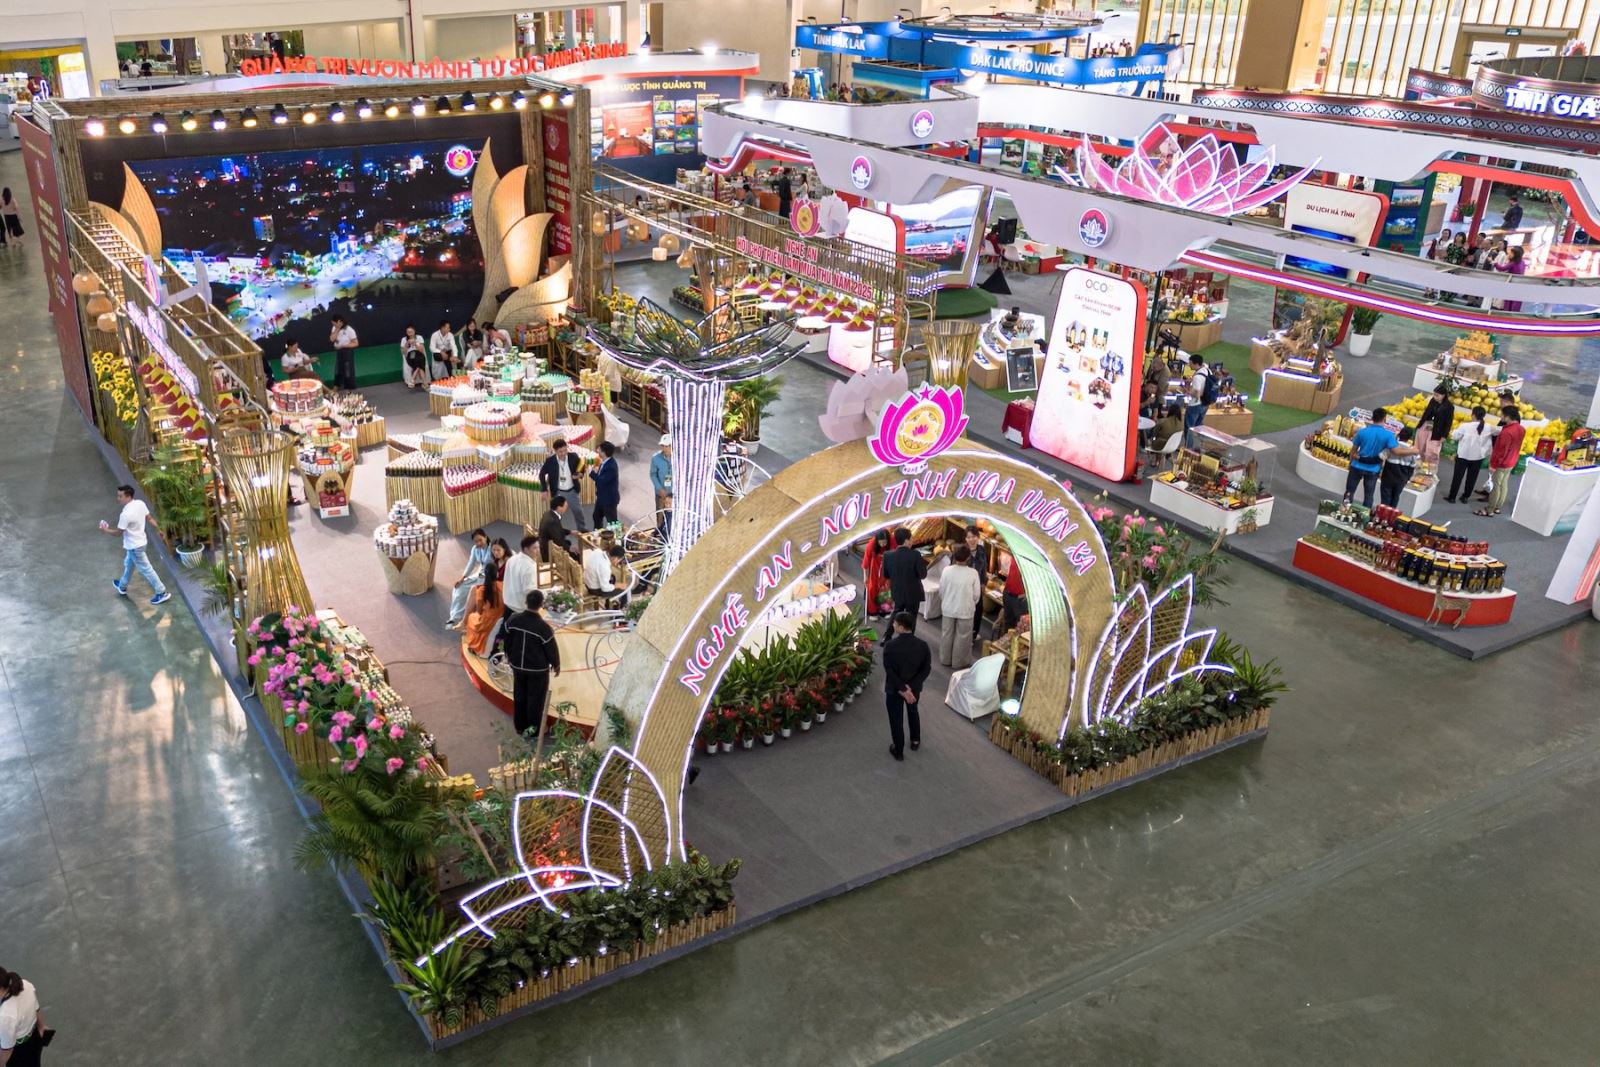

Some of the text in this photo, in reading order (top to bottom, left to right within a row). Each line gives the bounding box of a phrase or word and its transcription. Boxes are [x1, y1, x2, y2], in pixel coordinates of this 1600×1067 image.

[240, 52, 317, 78] QUẢNG
[320, 55, 348, 79] TRỊ
[418, 55, 472, 80] MÌNH
[992, 55, 1012, 71] LAK
[662, 79, 692, 90] QUẢNG
[693, 80, 706, 91] TRỊ
[1552, 92, 1597, 119] GIA
[1306, 203, 1315, 211] DU
[1316, 205, 1330, 213] LỊCH
[1331, 207, 1339, 215] HÀ
[806, 244, 818, 262] AN
[817, 266, 832, 284] THU
[852, 281, 873, 299] 2025
[1085, 278, 1114, 293] OCO
[680, 593, 749, 697] NGHỆ
[755, 540, 793, 602] AN
[820, 493, 871, 547] NƠI
[884, 468, 957, 513] TINH
[956, 470, 1016, 505] HOA
[1016, 489, 1079, 542] VƯƠN
[1065, 541, 1097, 576] XA
